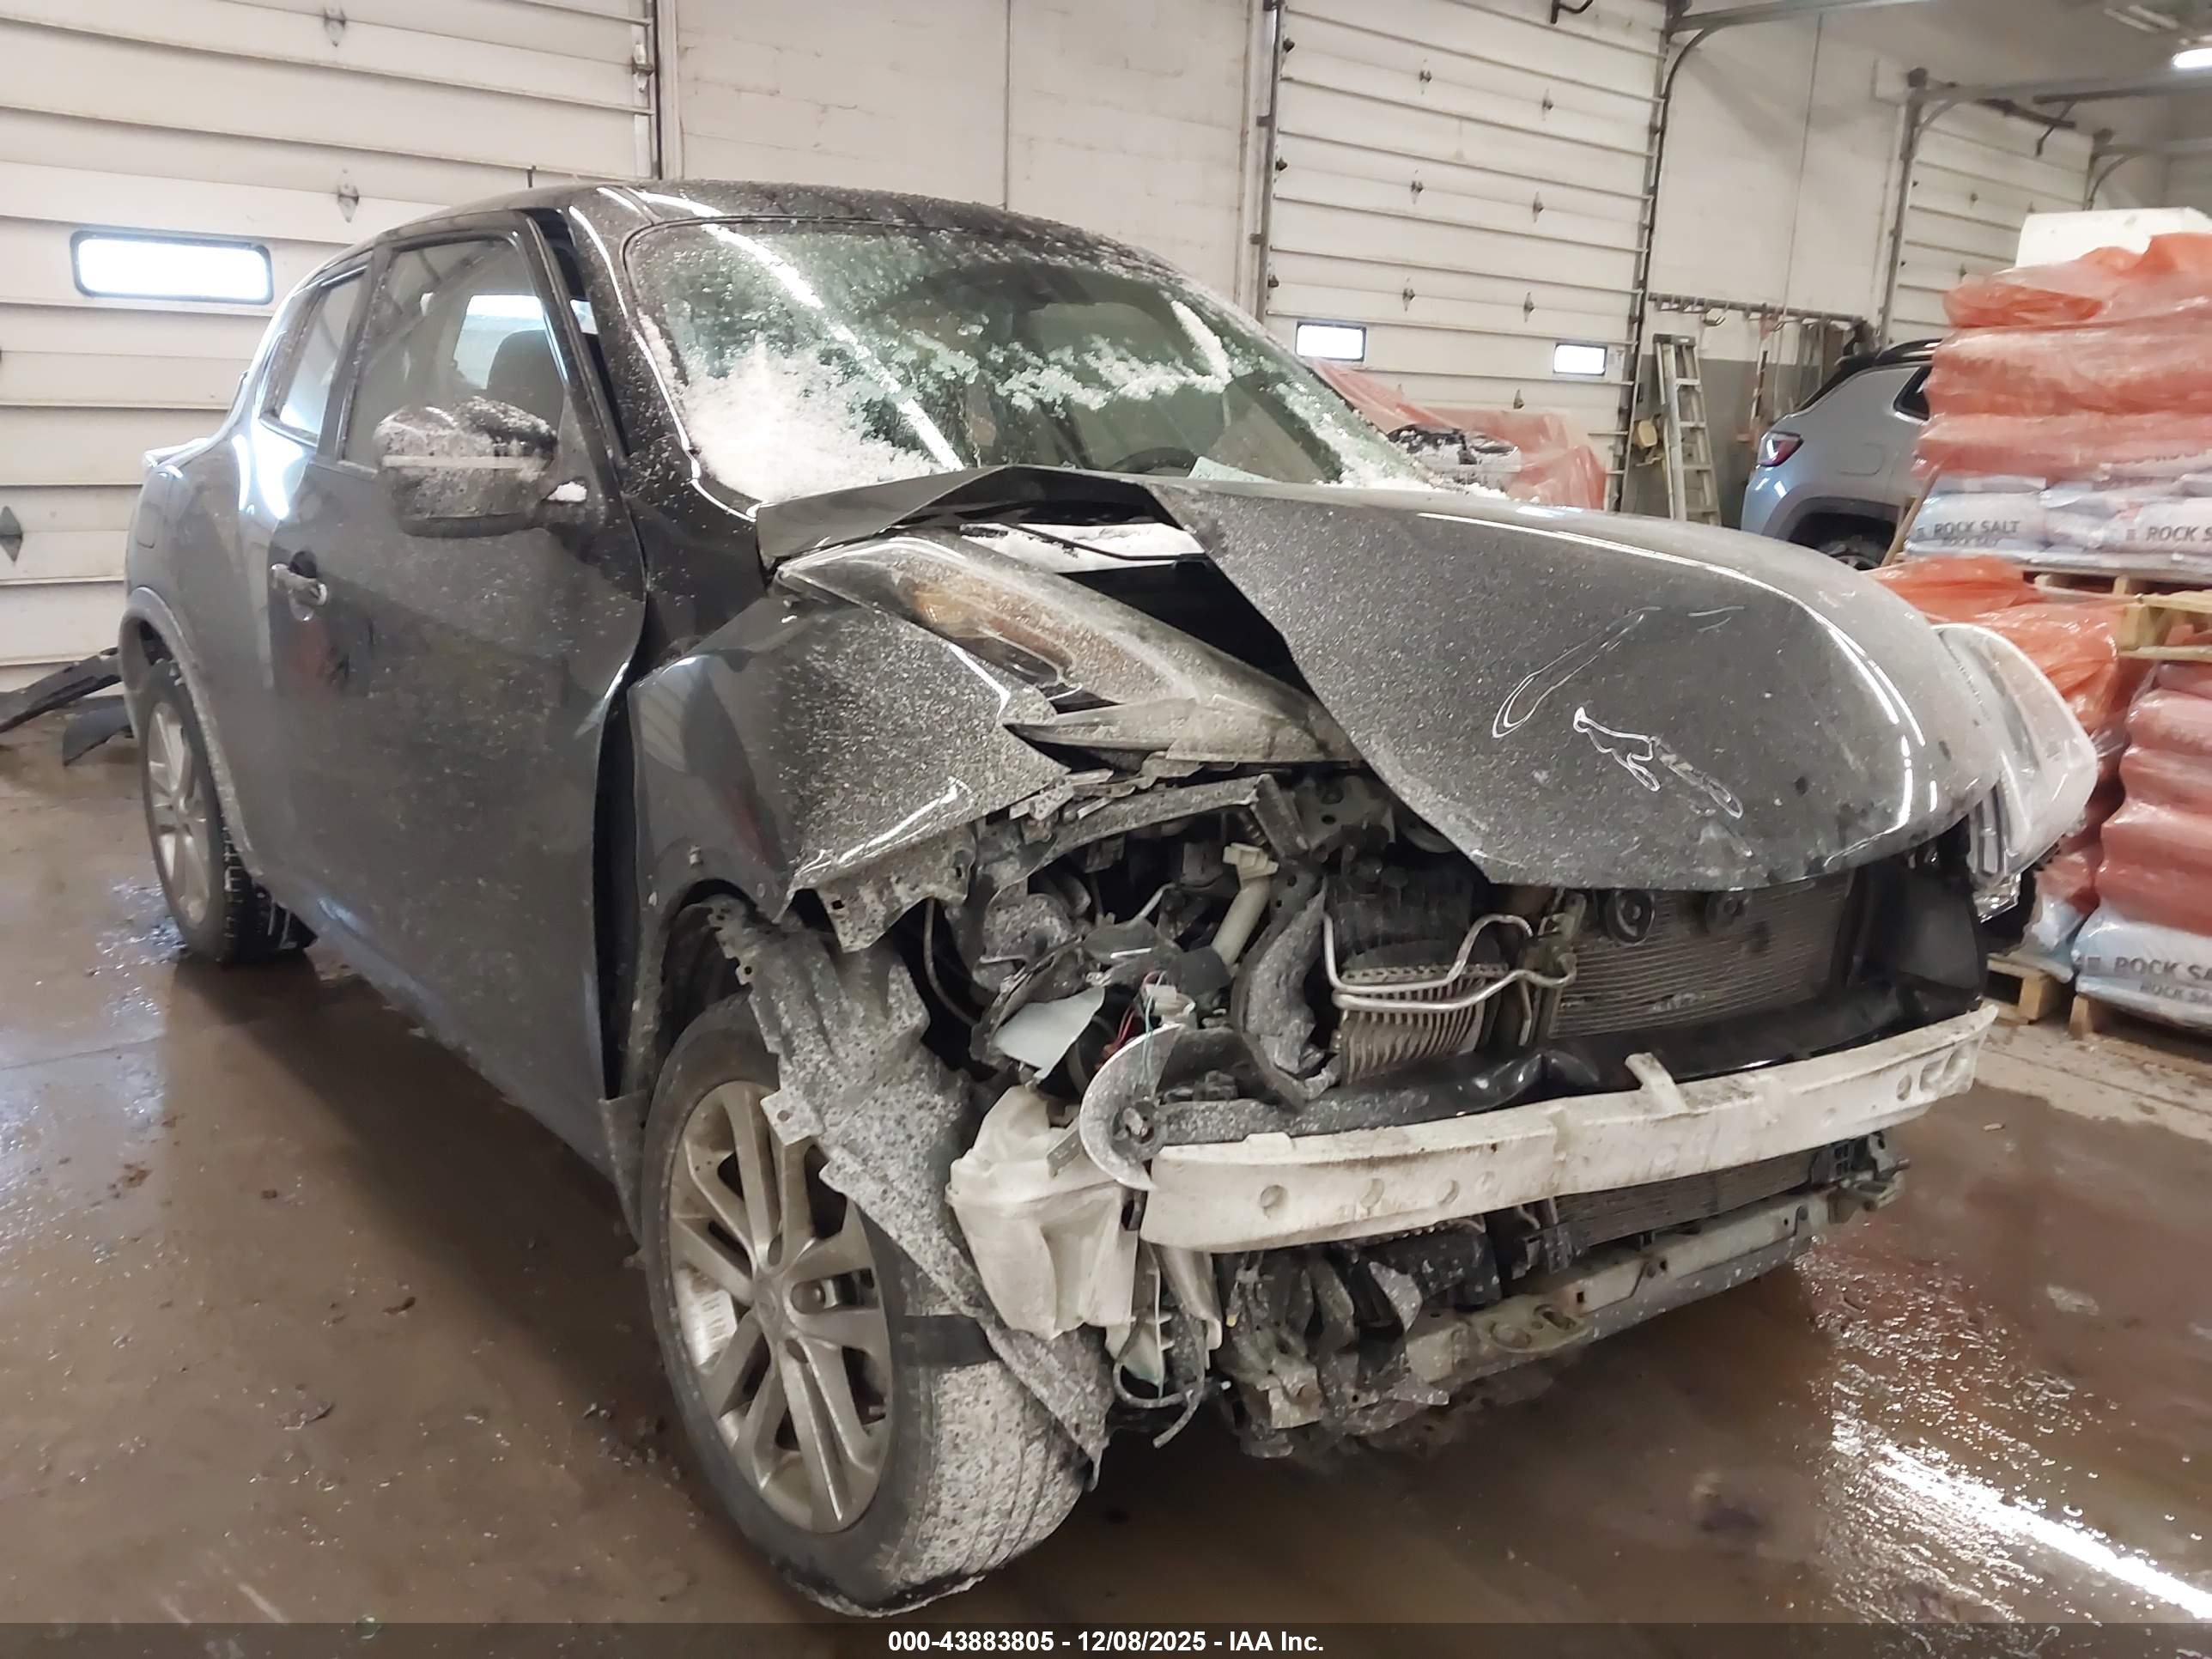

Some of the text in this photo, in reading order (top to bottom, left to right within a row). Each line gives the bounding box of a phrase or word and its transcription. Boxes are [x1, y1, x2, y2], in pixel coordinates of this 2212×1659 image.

[1933, 520, 2021, 538] ROCK SALT
[2146, 525, 2199, 542] ROCK
[2114, 956, 2179, 978] ROCK
